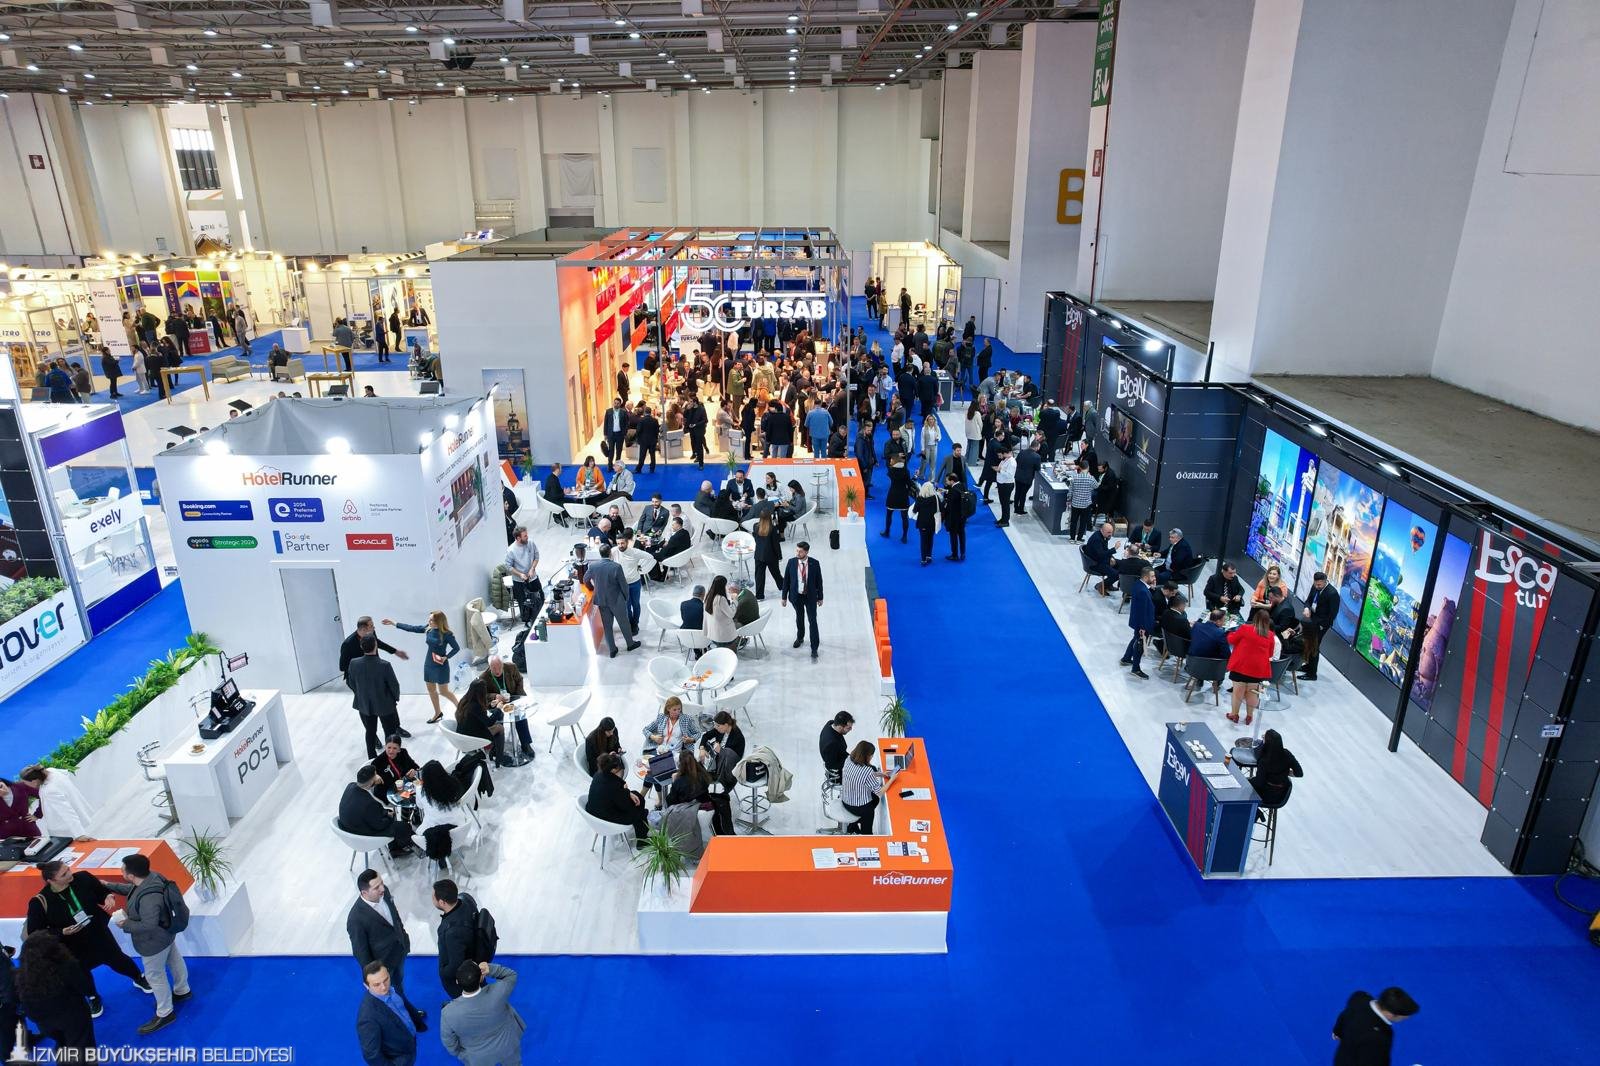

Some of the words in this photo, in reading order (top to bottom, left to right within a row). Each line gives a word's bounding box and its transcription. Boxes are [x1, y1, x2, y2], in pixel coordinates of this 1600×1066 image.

[241, 471, 338, 486] HotelRunner
[89, 507, 122, 534] exely
[341, 514, 362, 522] airbnb
[284, 532, 311, 541] Google
[286, 540, 330, 551] Partner
[1474, 529, 1559, 594] Esca
[1514, 588, 1548, 609] tur
[237, 738, 270, 785] POS
[872, 875, 948, 885] HotelRunner
